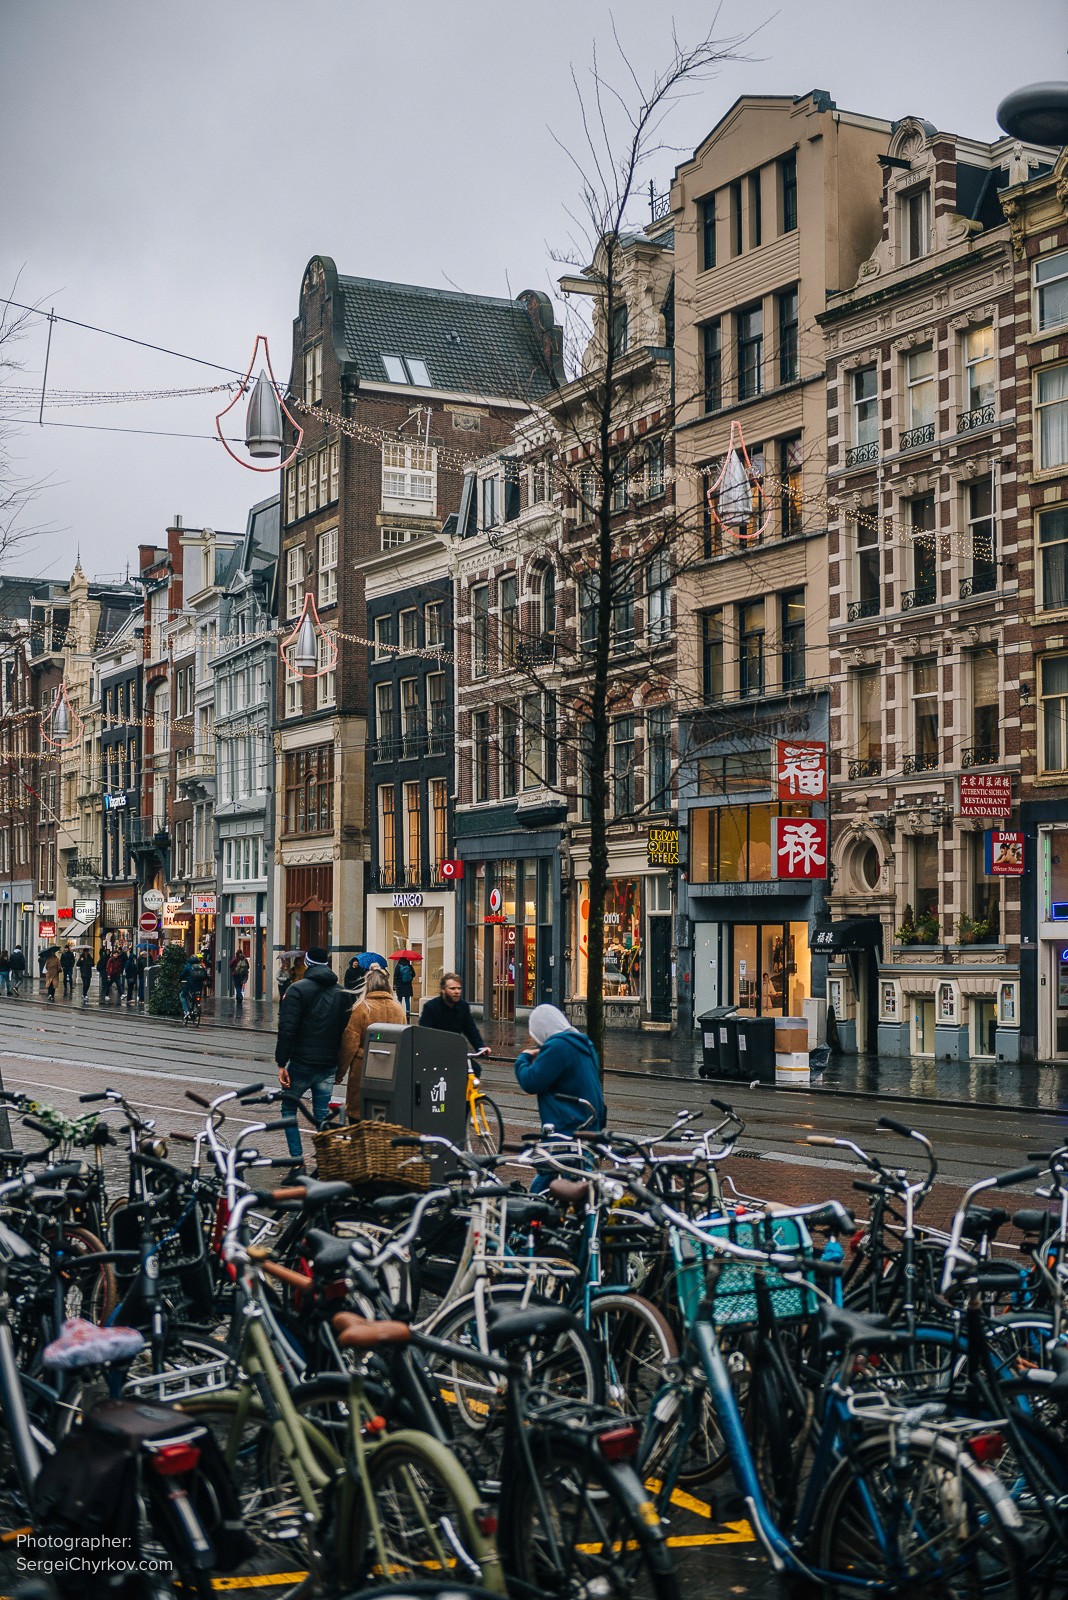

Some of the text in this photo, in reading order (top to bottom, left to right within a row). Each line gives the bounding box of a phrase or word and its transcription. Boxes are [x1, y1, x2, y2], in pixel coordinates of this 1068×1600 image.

[778, 747, 825, 796] 福
[964, 797, 1007, 805] RESTAURANT
[961, 806, 1010, 817] MANDARIJN
[649, 829, 679, 841] URBAN
[999, 833, 1017, 841] DAM
[648, 840, 679, 853] OUTFI
[649, 852, 680, 865] TTERS
[392, 893, 423, 907] MANGO
